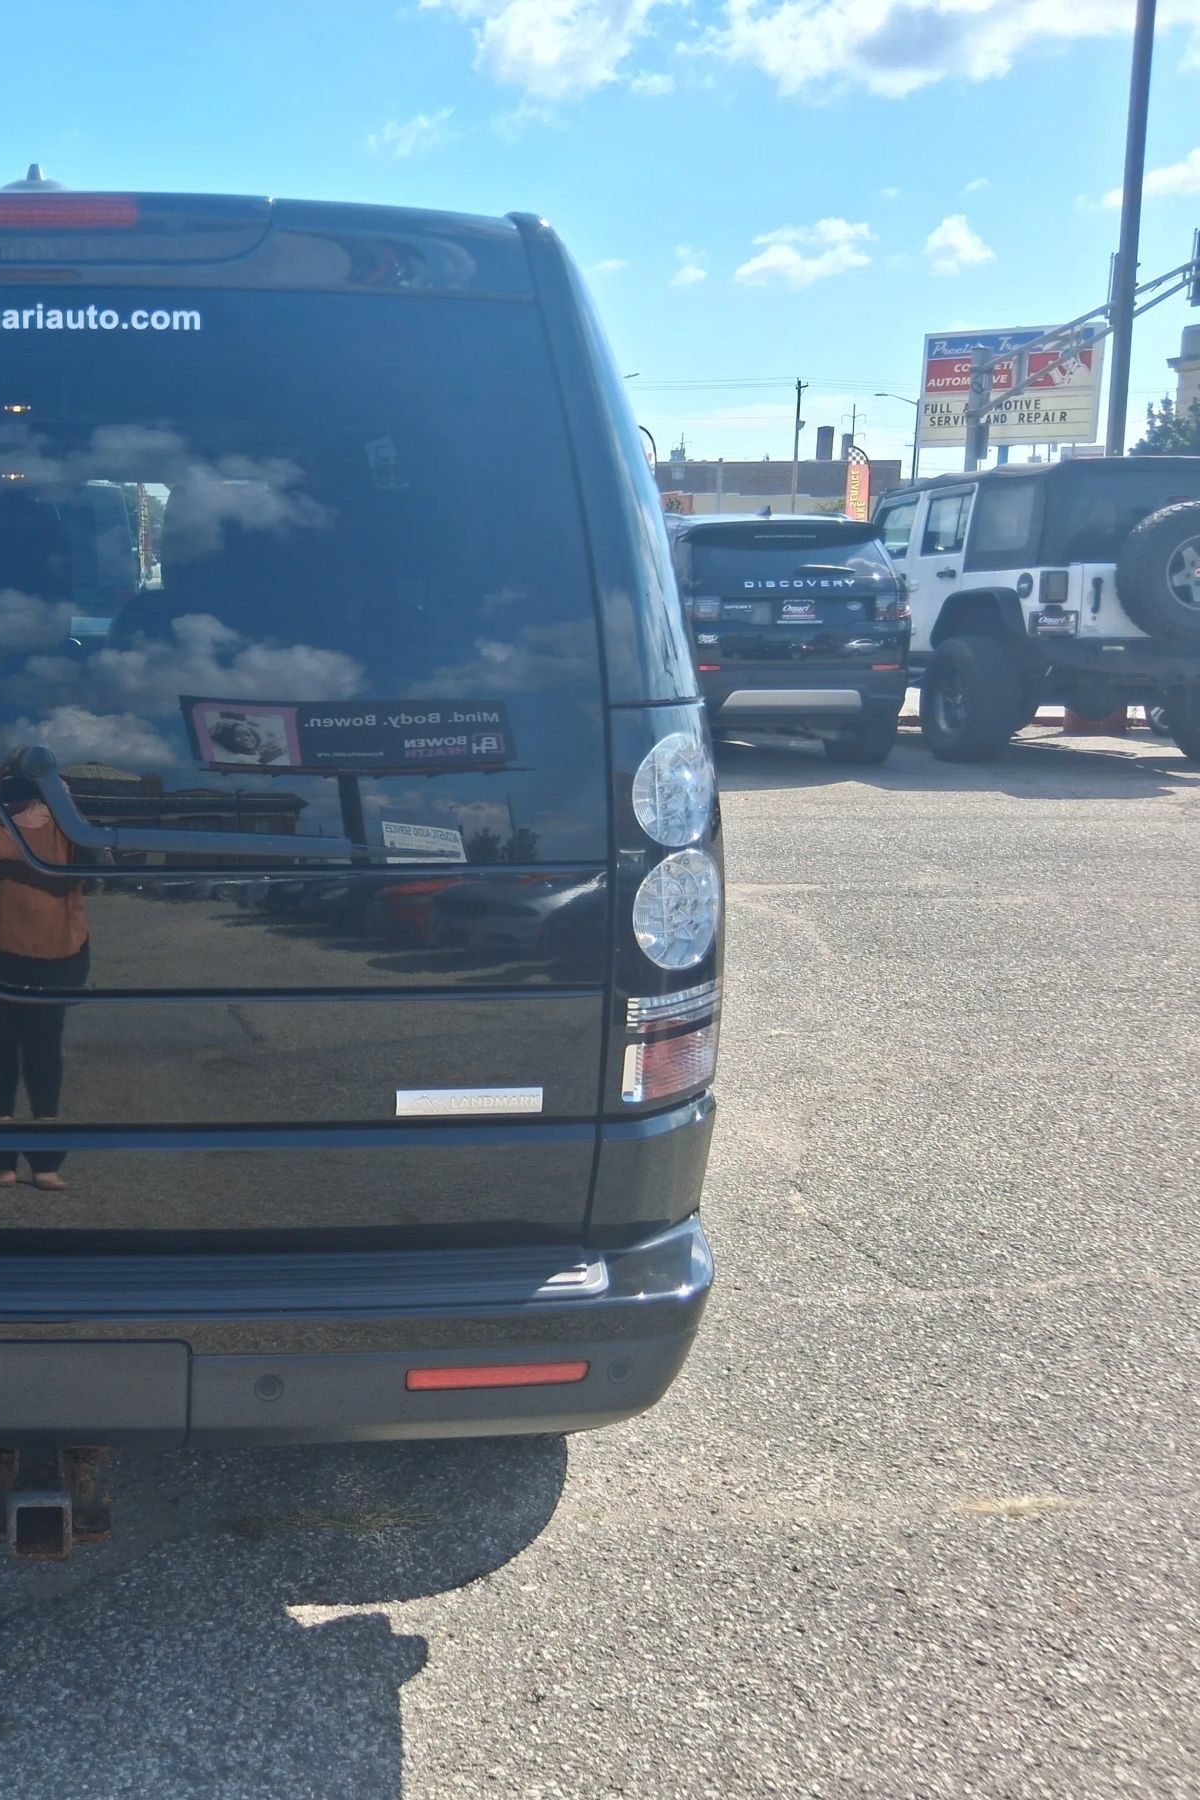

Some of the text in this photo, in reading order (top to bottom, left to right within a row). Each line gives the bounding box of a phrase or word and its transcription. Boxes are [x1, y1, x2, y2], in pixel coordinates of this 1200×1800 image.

[926, 375, 1008, 388] AUTOMVE
[924, 399, 1041, 414] FULL AMOTIVE
[929, 411, 1068, 427] SERVI AND REPAIR
[744, 580, 855, 588] DISCOVERY
[451, 1094, 540, 1109] LANDMARK
